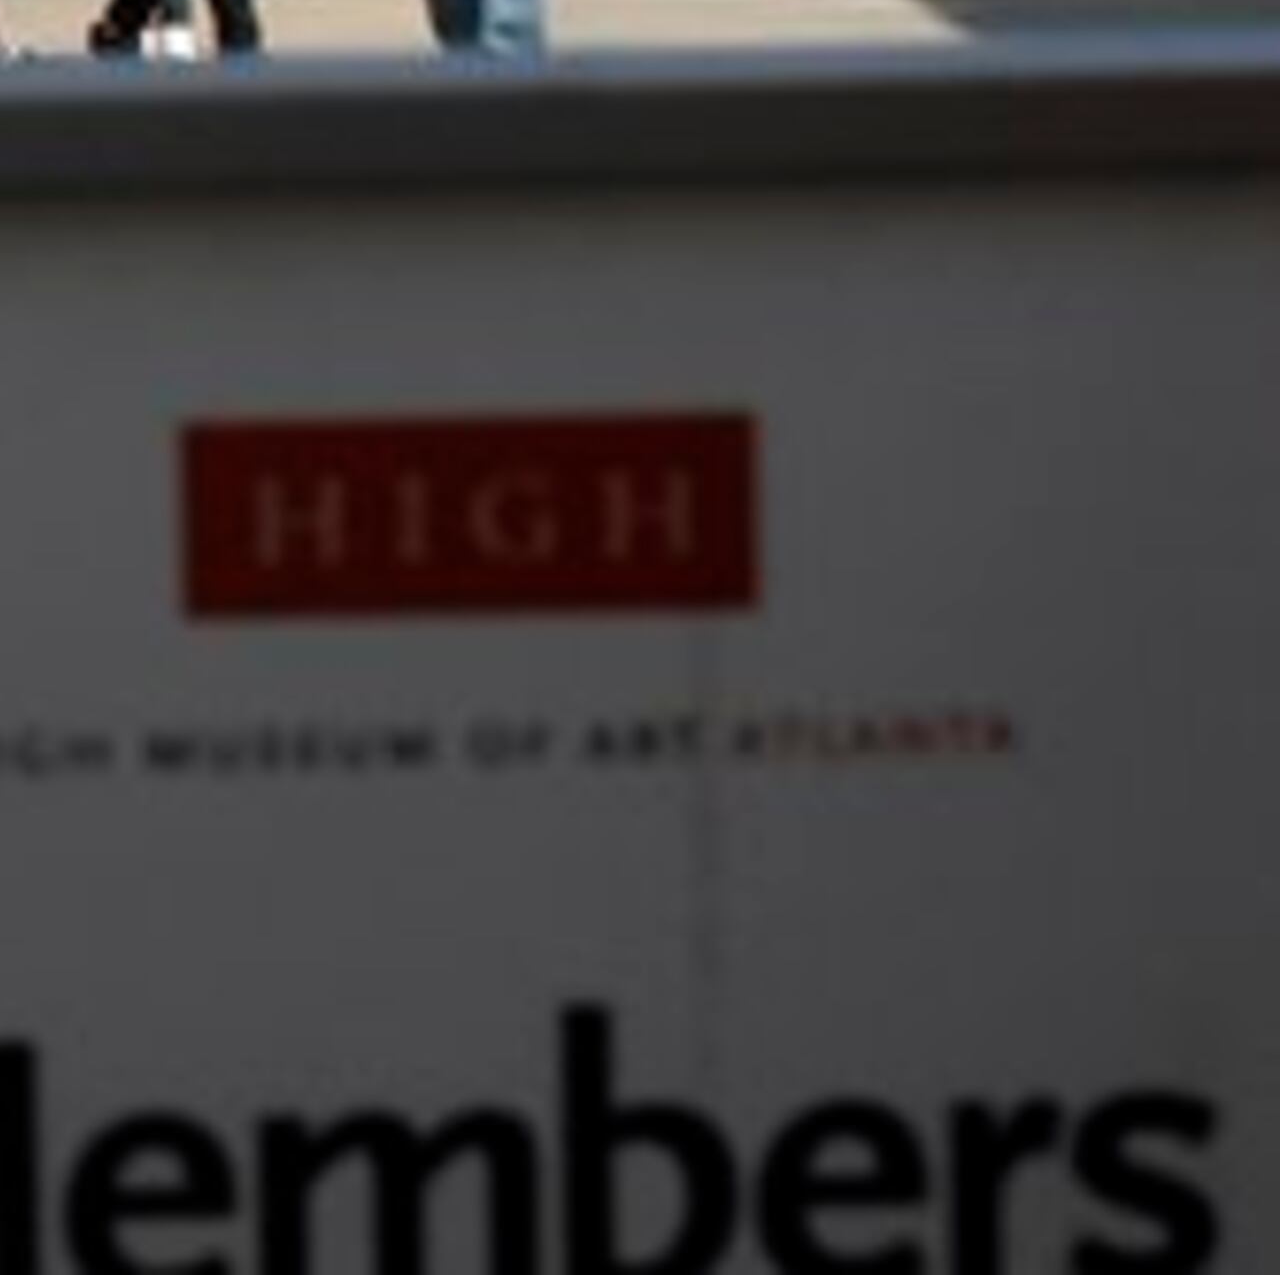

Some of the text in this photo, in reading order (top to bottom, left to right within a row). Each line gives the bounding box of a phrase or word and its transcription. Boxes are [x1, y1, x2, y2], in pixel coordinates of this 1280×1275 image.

[248, 465, 702, 570] HIGH
[142, 725, 436, 774] MUSEUM
[465, 722, 554, 767] OF
[582, 716, 706, 762] ART
[728, 711, 1018, 759] ATLANTA
